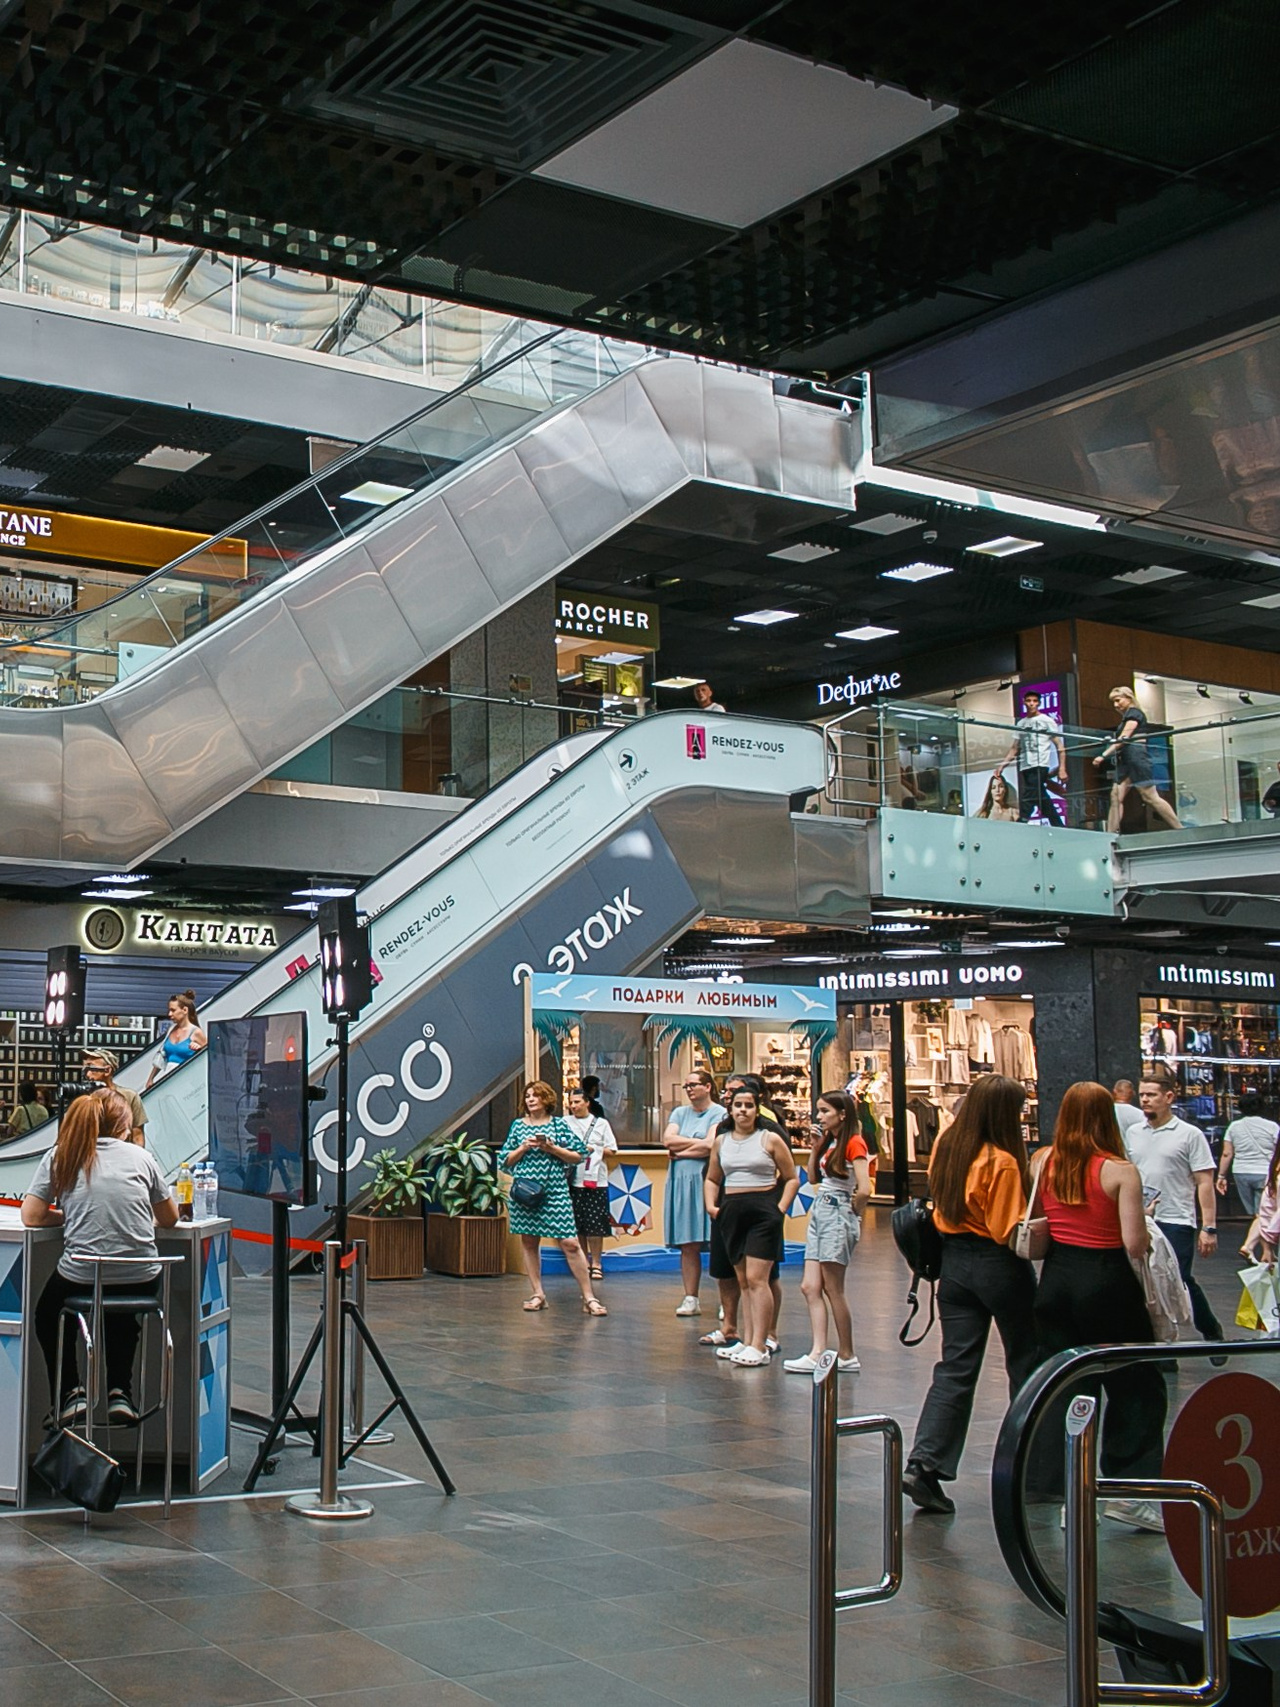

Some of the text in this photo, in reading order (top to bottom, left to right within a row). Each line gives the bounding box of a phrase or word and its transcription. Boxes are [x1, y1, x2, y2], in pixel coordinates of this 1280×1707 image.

[555, 619, 603, 634] RANCE
[561, 600, 649, 629] ROCHER
[712, 735, 784, 753] RENDEZ-VOUS
[631, 768, 650, 786] ЭТАЖ
[138, 915, 277, 947] КАНТАТА
[378, 894, 455, 959] RENDEZ-VOUS
[170, 946, 238, 958] галерея вкусов
[819, 965, 1022, 990] intimissimi UOMO
[1160, 964, 1275, 988] intimissimi
[612, 987, 778, 1008] ПОДАРКИ ЛЮБИМЫМ
[313, 1039, 452, 1190] CCO
[1215, 1413, 1263, 1520] 3
[1224, 1525, 1280, 1560] таж
